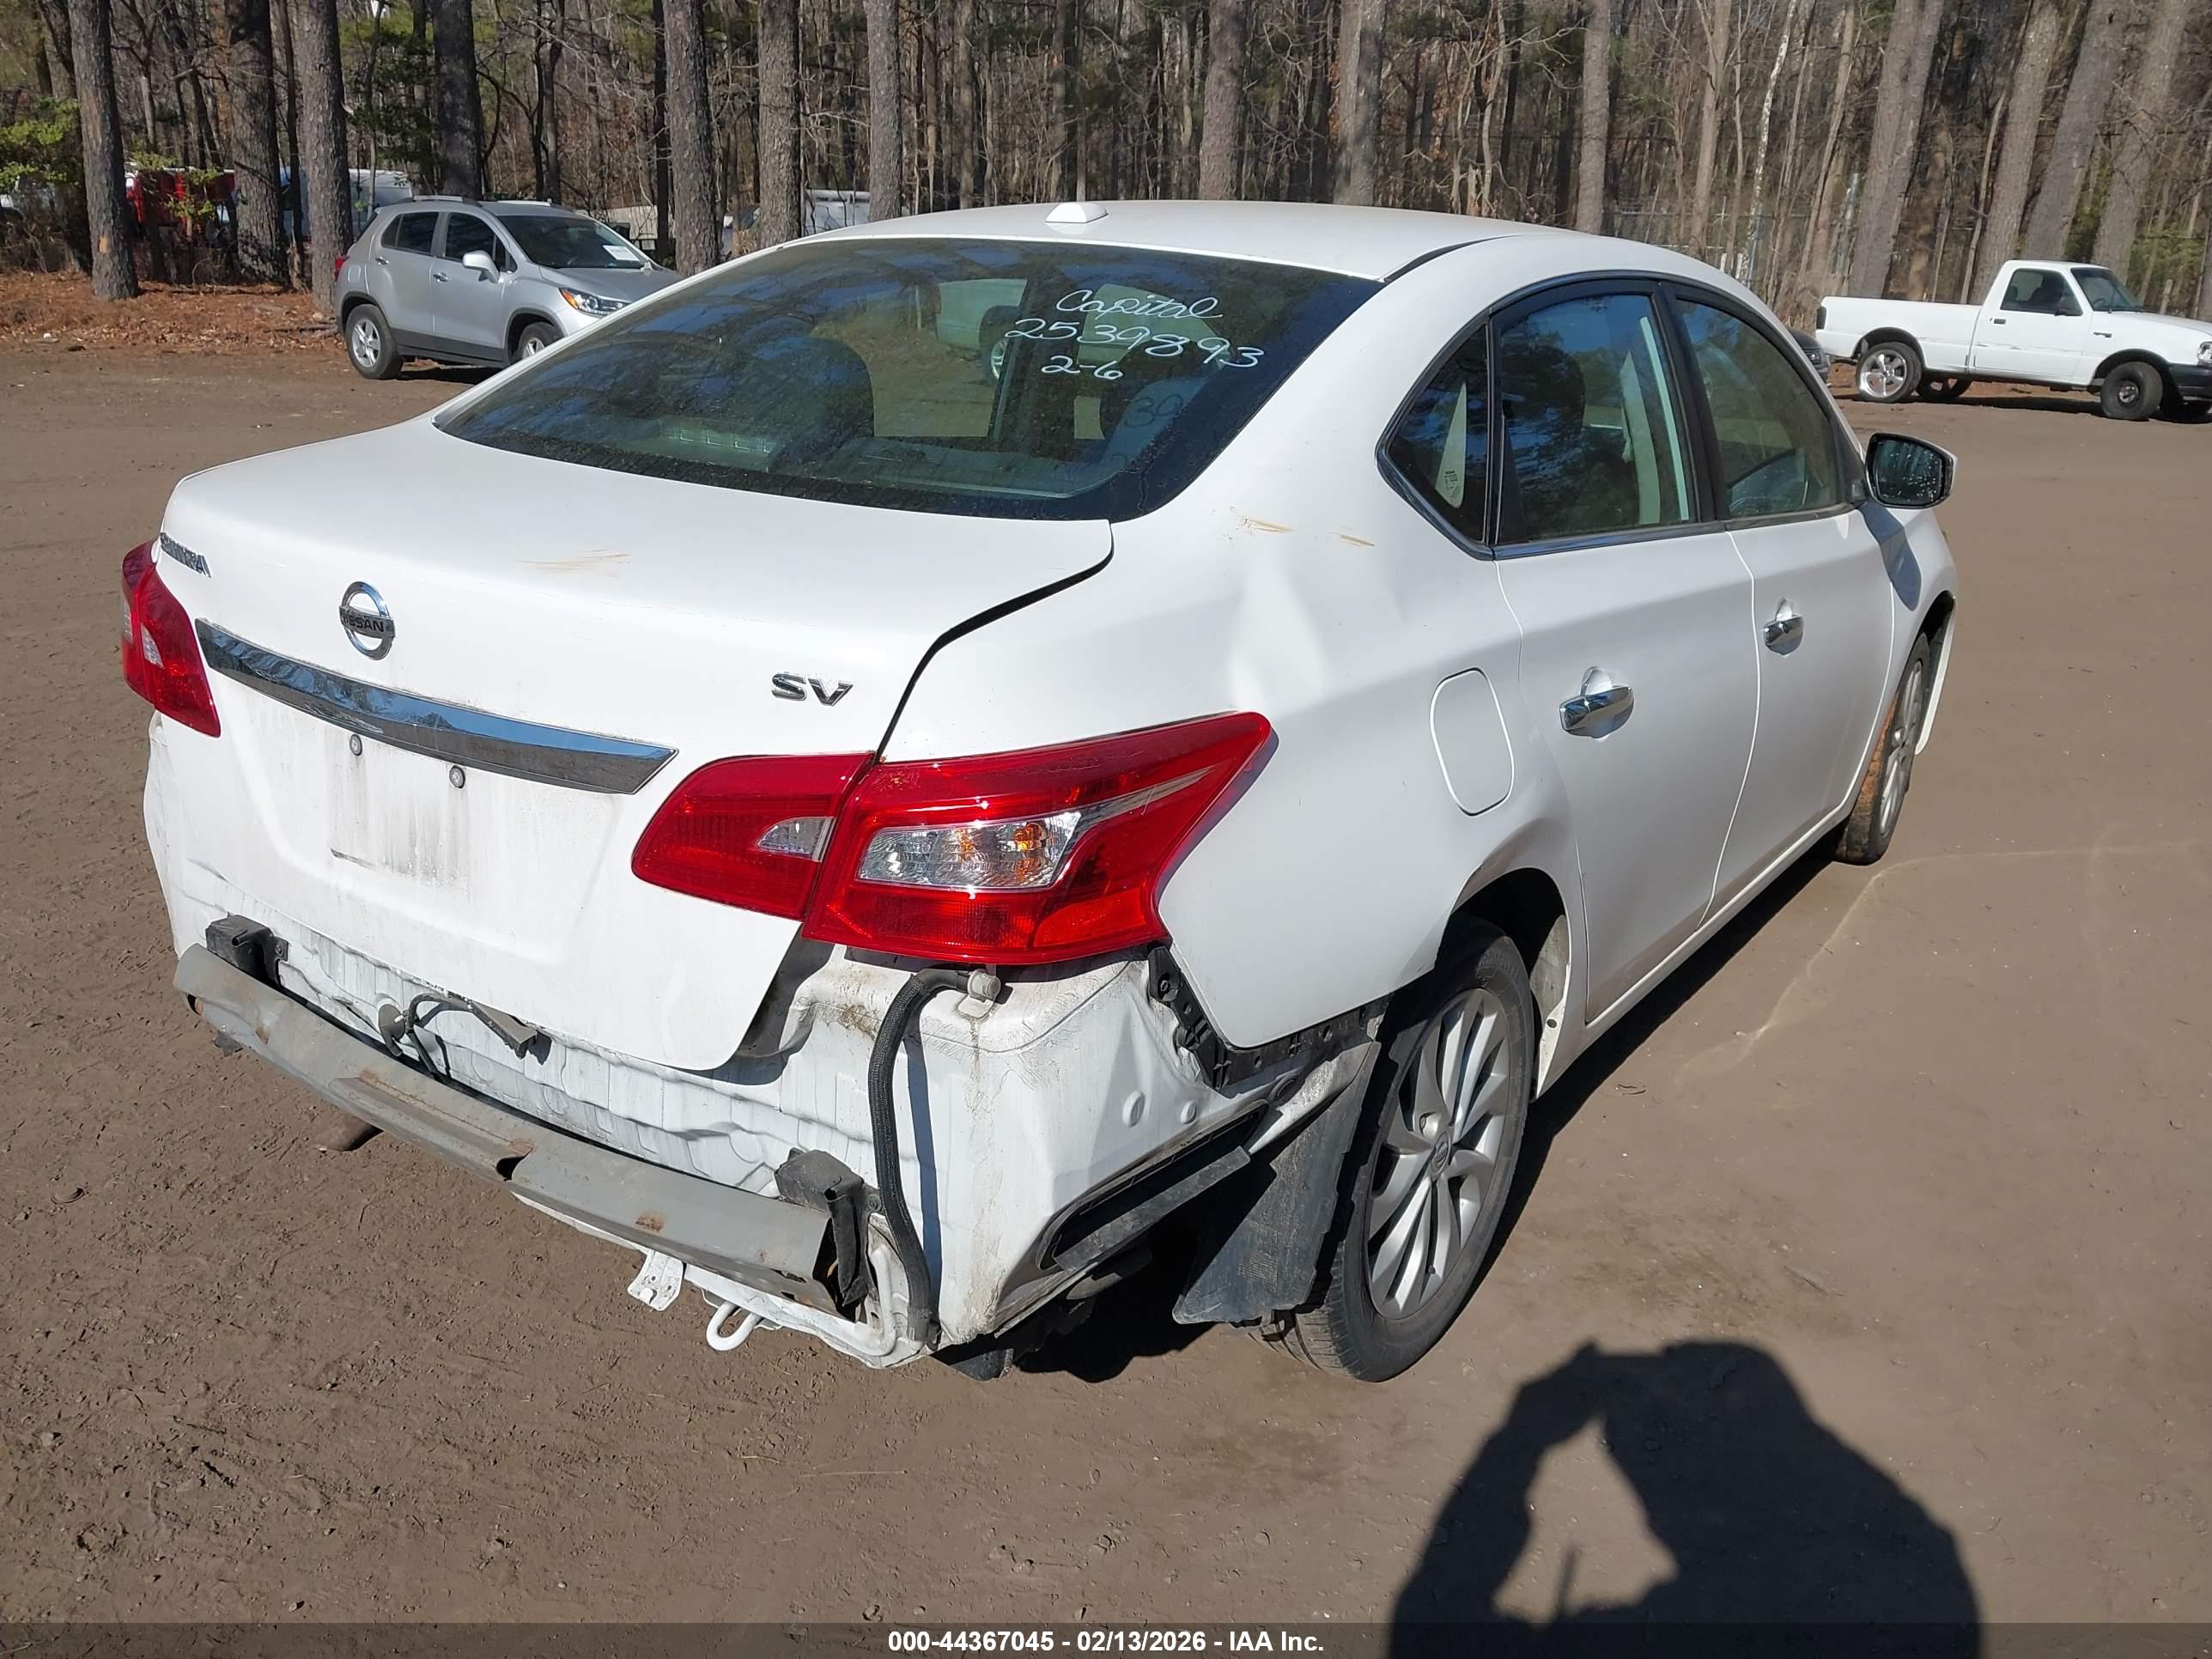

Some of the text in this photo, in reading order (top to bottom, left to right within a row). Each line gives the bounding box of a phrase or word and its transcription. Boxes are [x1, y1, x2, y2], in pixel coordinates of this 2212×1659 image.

[1004, 318, 1265, 368] 2539893
[1041, 355, 1124, 380] 2-6
[771, 672, 854, 707] SV
